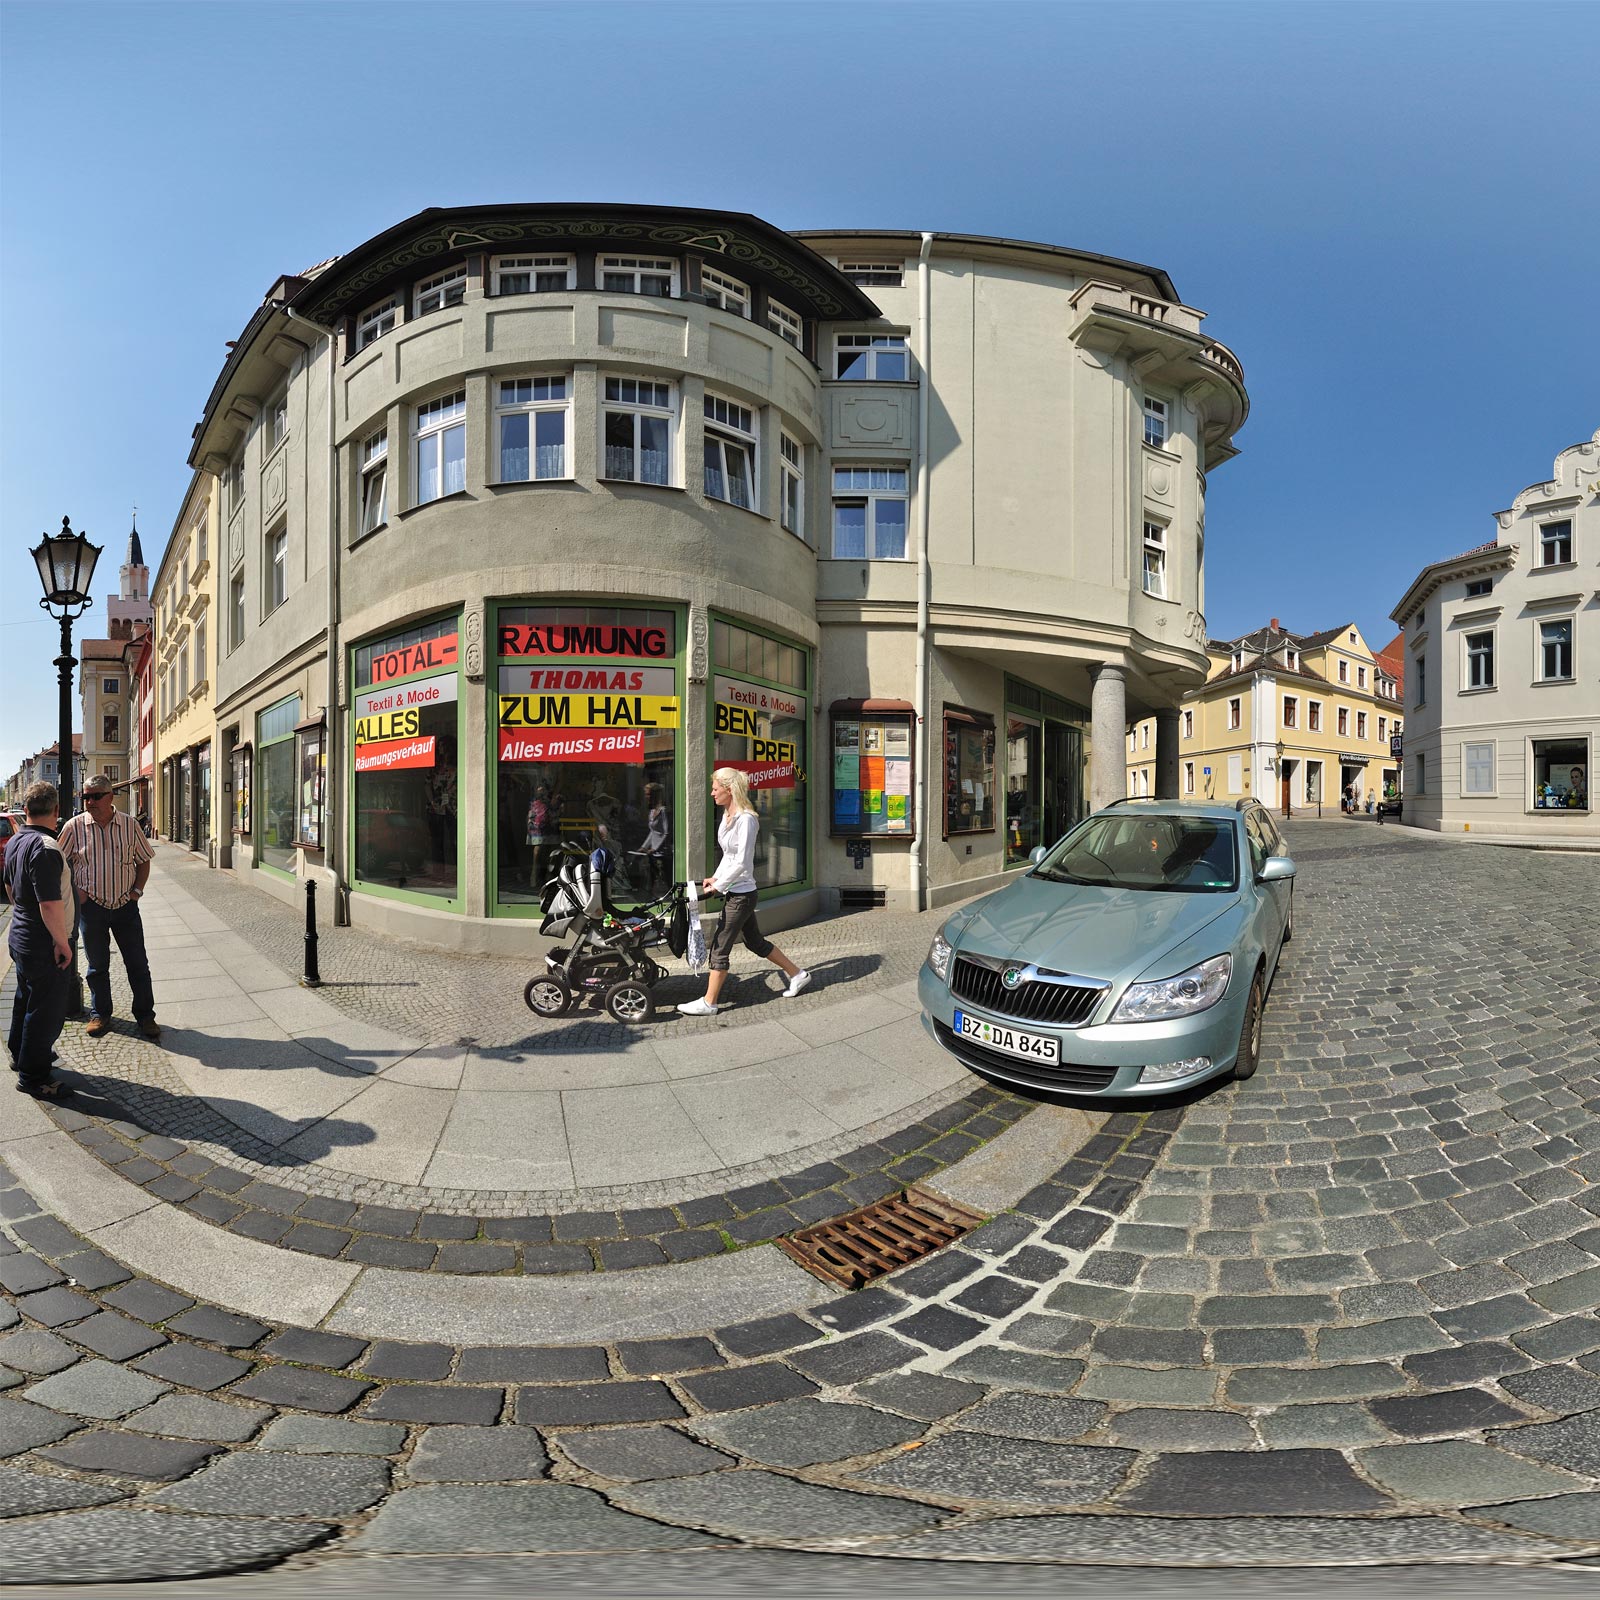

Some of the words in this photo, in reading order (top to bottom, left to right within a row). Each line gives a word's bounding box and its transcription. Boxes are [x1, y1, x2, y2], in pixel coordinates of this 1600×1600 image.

[500, 626, 666, 656] RÄUMUNG
[373, 643, 456, 681] TOTAL-
[530, 670, 643, 691] THOMAS
[367, 695, 393, 713] Textil
[395, 693, 404, 707] &
[407, 686, 440, 705] Mode
[500, 696, 570, 725] ZUM
[588, 697, 677, 726] HAL-
[728, 687, 757, 705] Textil
[760, 694, 768, 708] &
[770, 697, 796, 714] Mode
[356, 709, 418, 743] ALLES
[715, 703, 757, 736] BEN
[355, 735, 435, 771] Räumungsverkauf
[500, 741, 543, 761] Alles
[547, 736, 593, 756] muss
[597, 730, 642, 752] raus!
[747, 761, 794, 786] ngsverkauf
[963, 1017, 981, 1038] BZ
[992, 1028, 1014, 1049] DA
[1019, 1036, 1055, 1058] 845
